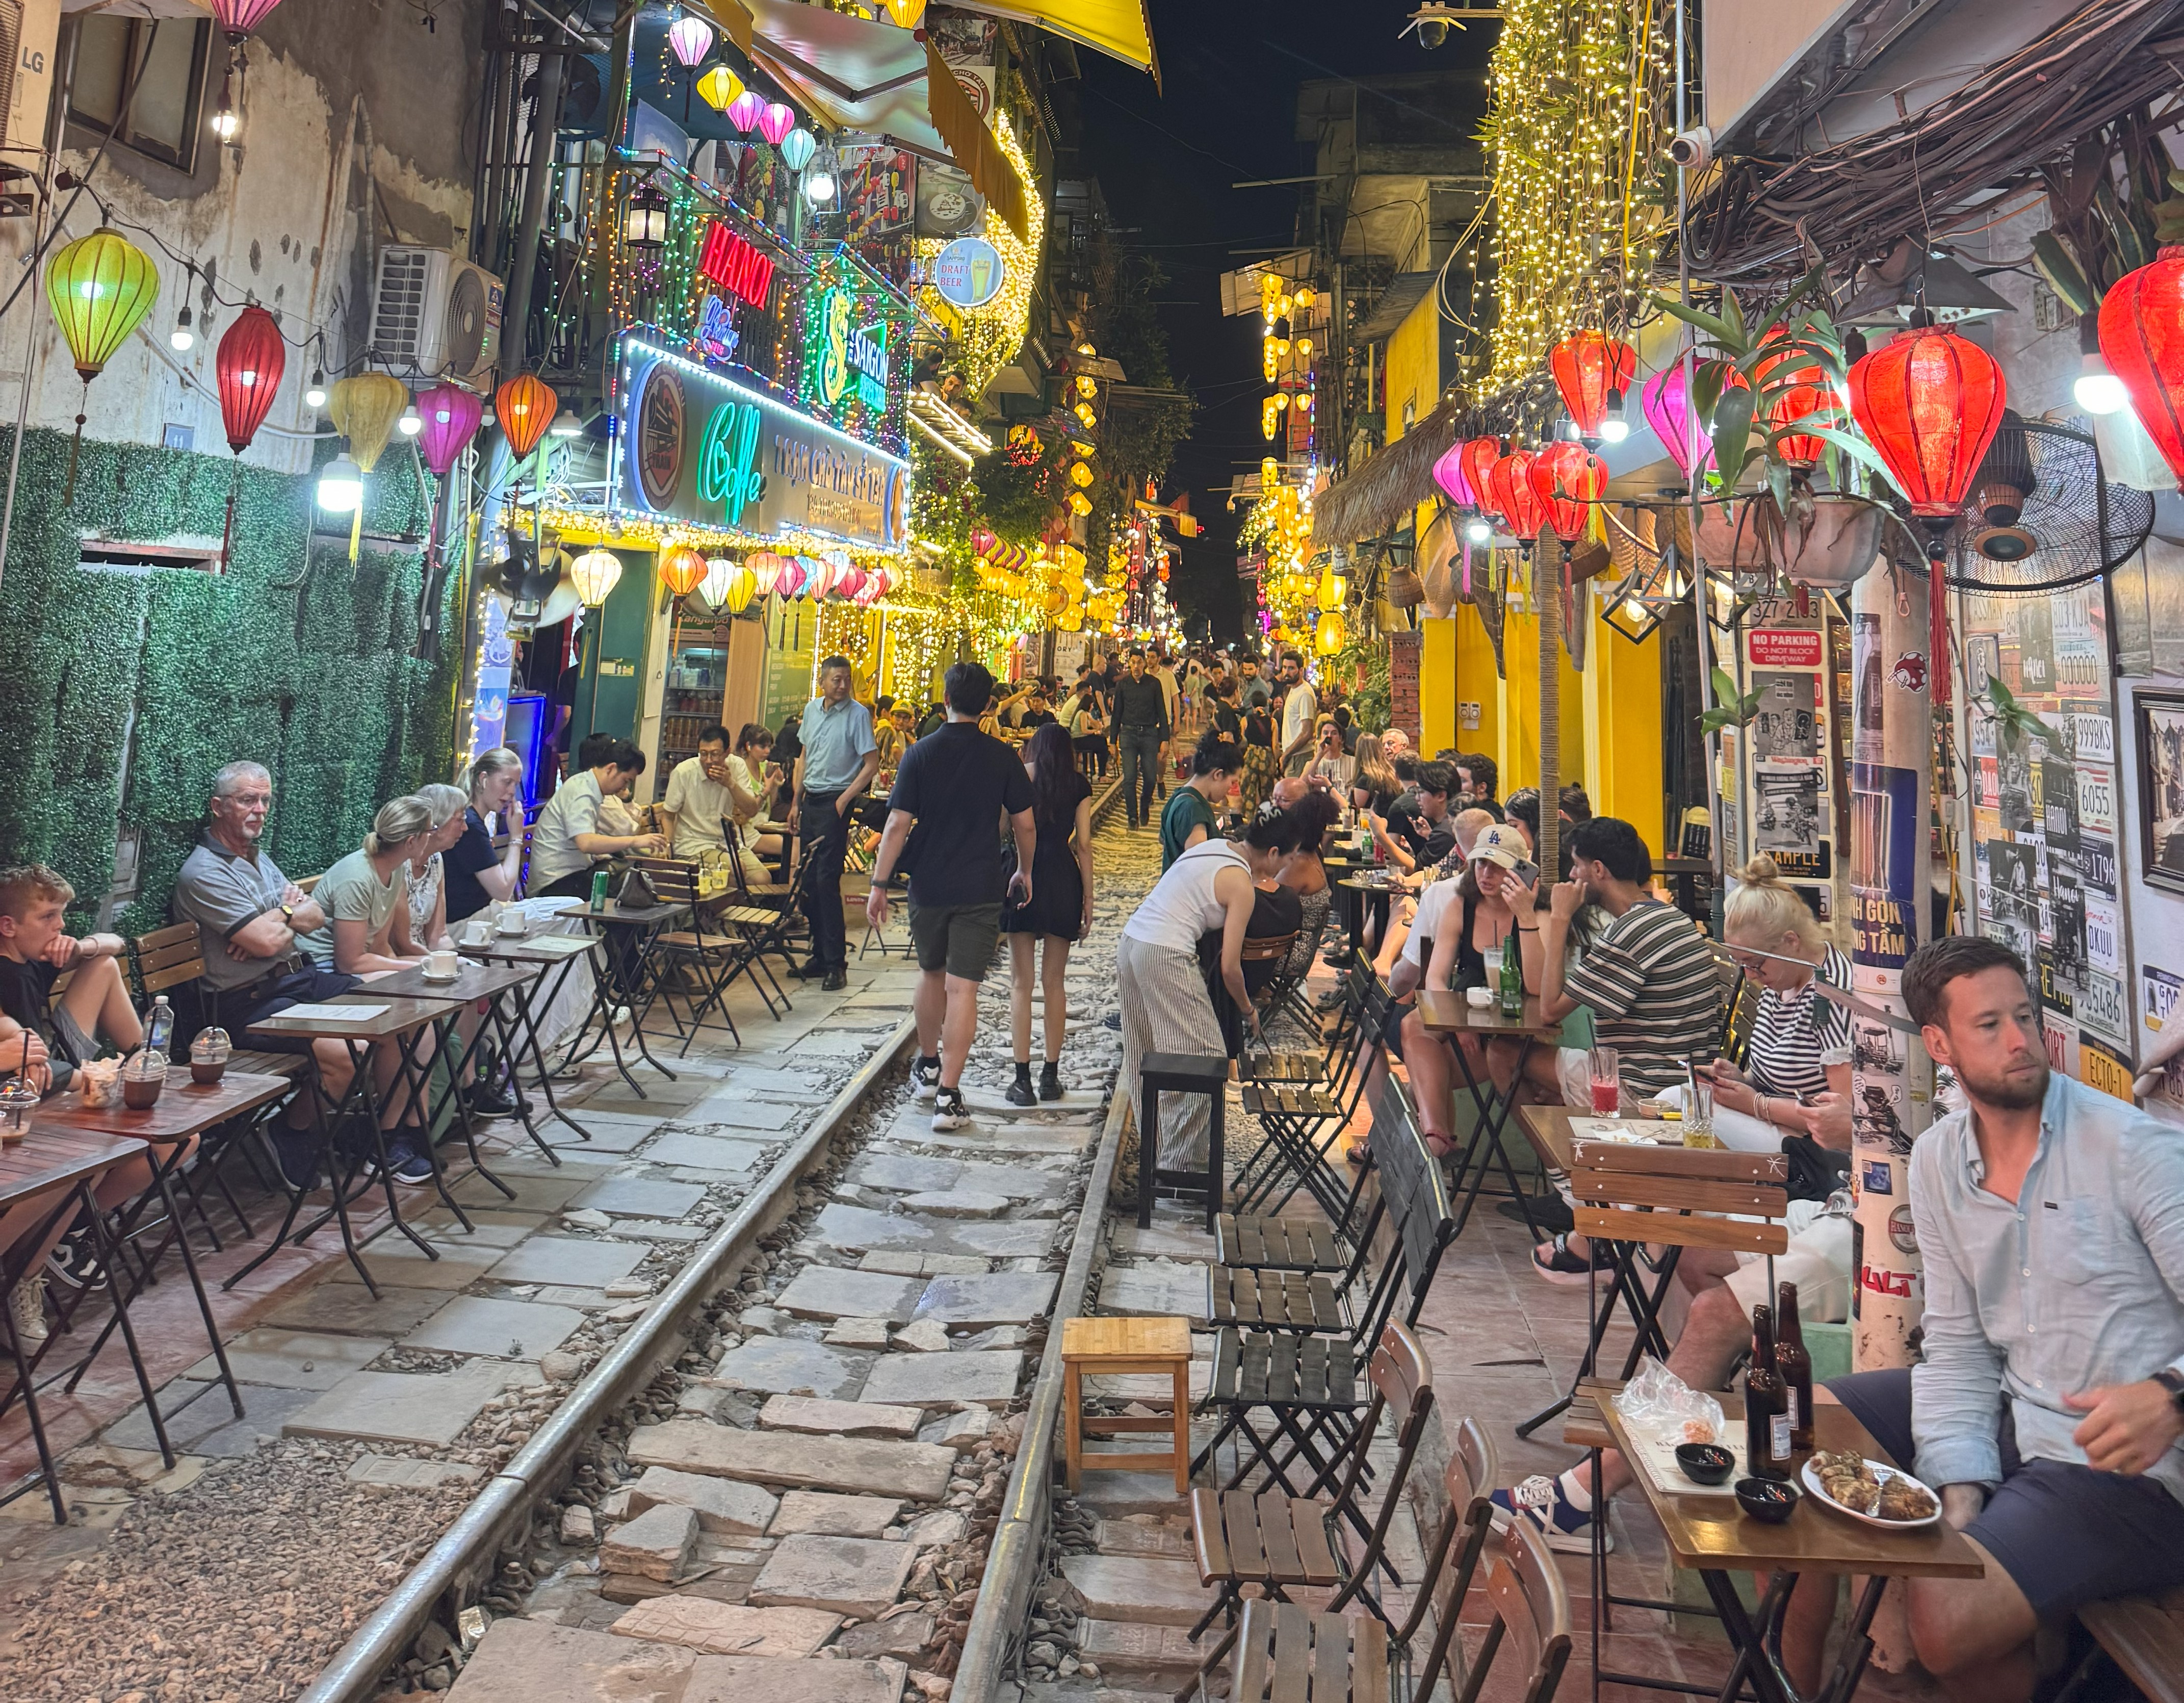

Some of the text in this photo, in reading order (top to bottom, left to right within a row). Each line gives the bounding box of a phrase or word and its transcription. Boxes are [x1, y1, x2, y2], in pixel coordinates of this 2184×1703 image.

[22, 46, 44, 74] LG
[701, 221, 775, 311] HANOI
[942, 265, 971, 274] DRAFT
[940, 277, 962, 287] BEER
[854, 329, 890, 386] SAIGON
[1786, 601, 1818, 618] 213
[1753, 634, 1817, 646] NO PARKING
[2082, 784, 2110, 816] 6055
[2045, 804, 2068, 835] HANOI
[1489, 830, 1501, 845] LA
[1767, 850, 1821, 866] AMPLE
[2092, 853, 2115, 886] 1796
[2089, 1051, 2122, 1100] ECTO-1
